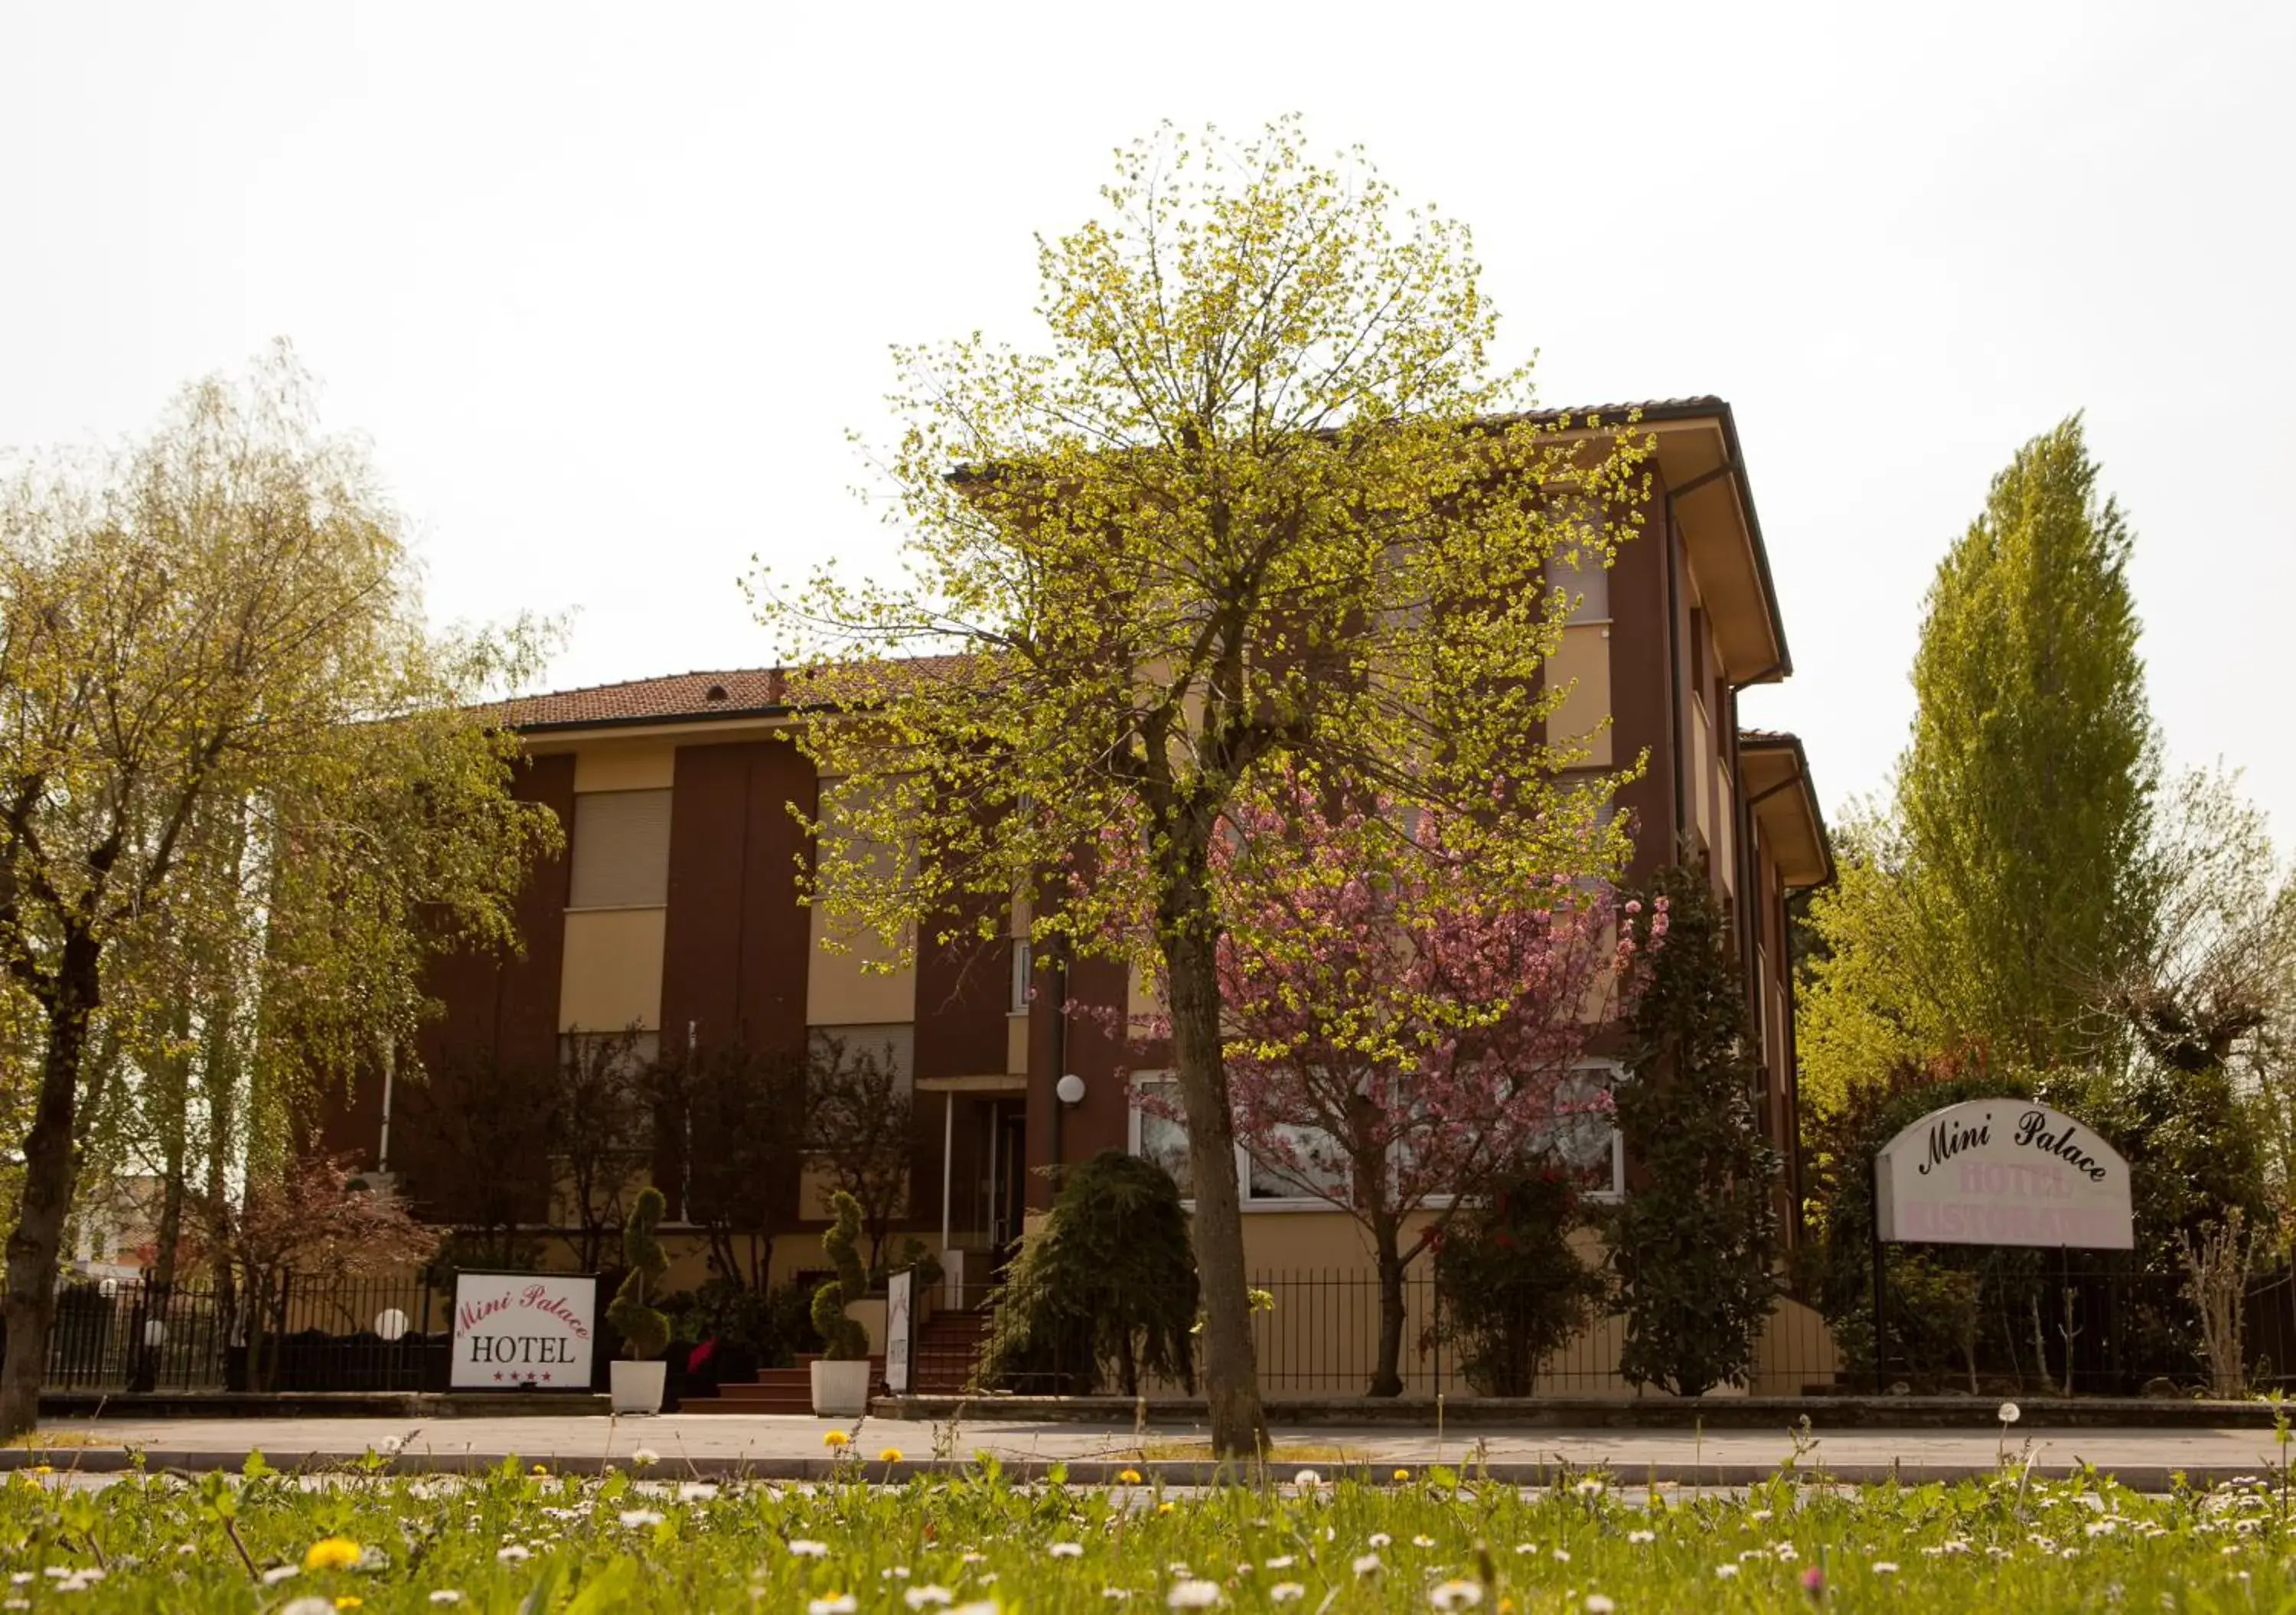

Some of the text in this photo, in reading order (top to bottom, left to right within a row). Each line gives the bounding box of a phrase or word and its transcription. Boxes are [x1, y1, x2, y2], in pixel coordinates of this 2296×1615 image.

[1918, 1111, 2106, 1183] Mini Palace
[1959, 1160, 2074, 1199] HOTEL
[1904, 1202, 2122, 1241] ISTORA
[457, 1284, 589, 1339] Mini Palace
[470, 1336, 576, 1363] HOTEL
